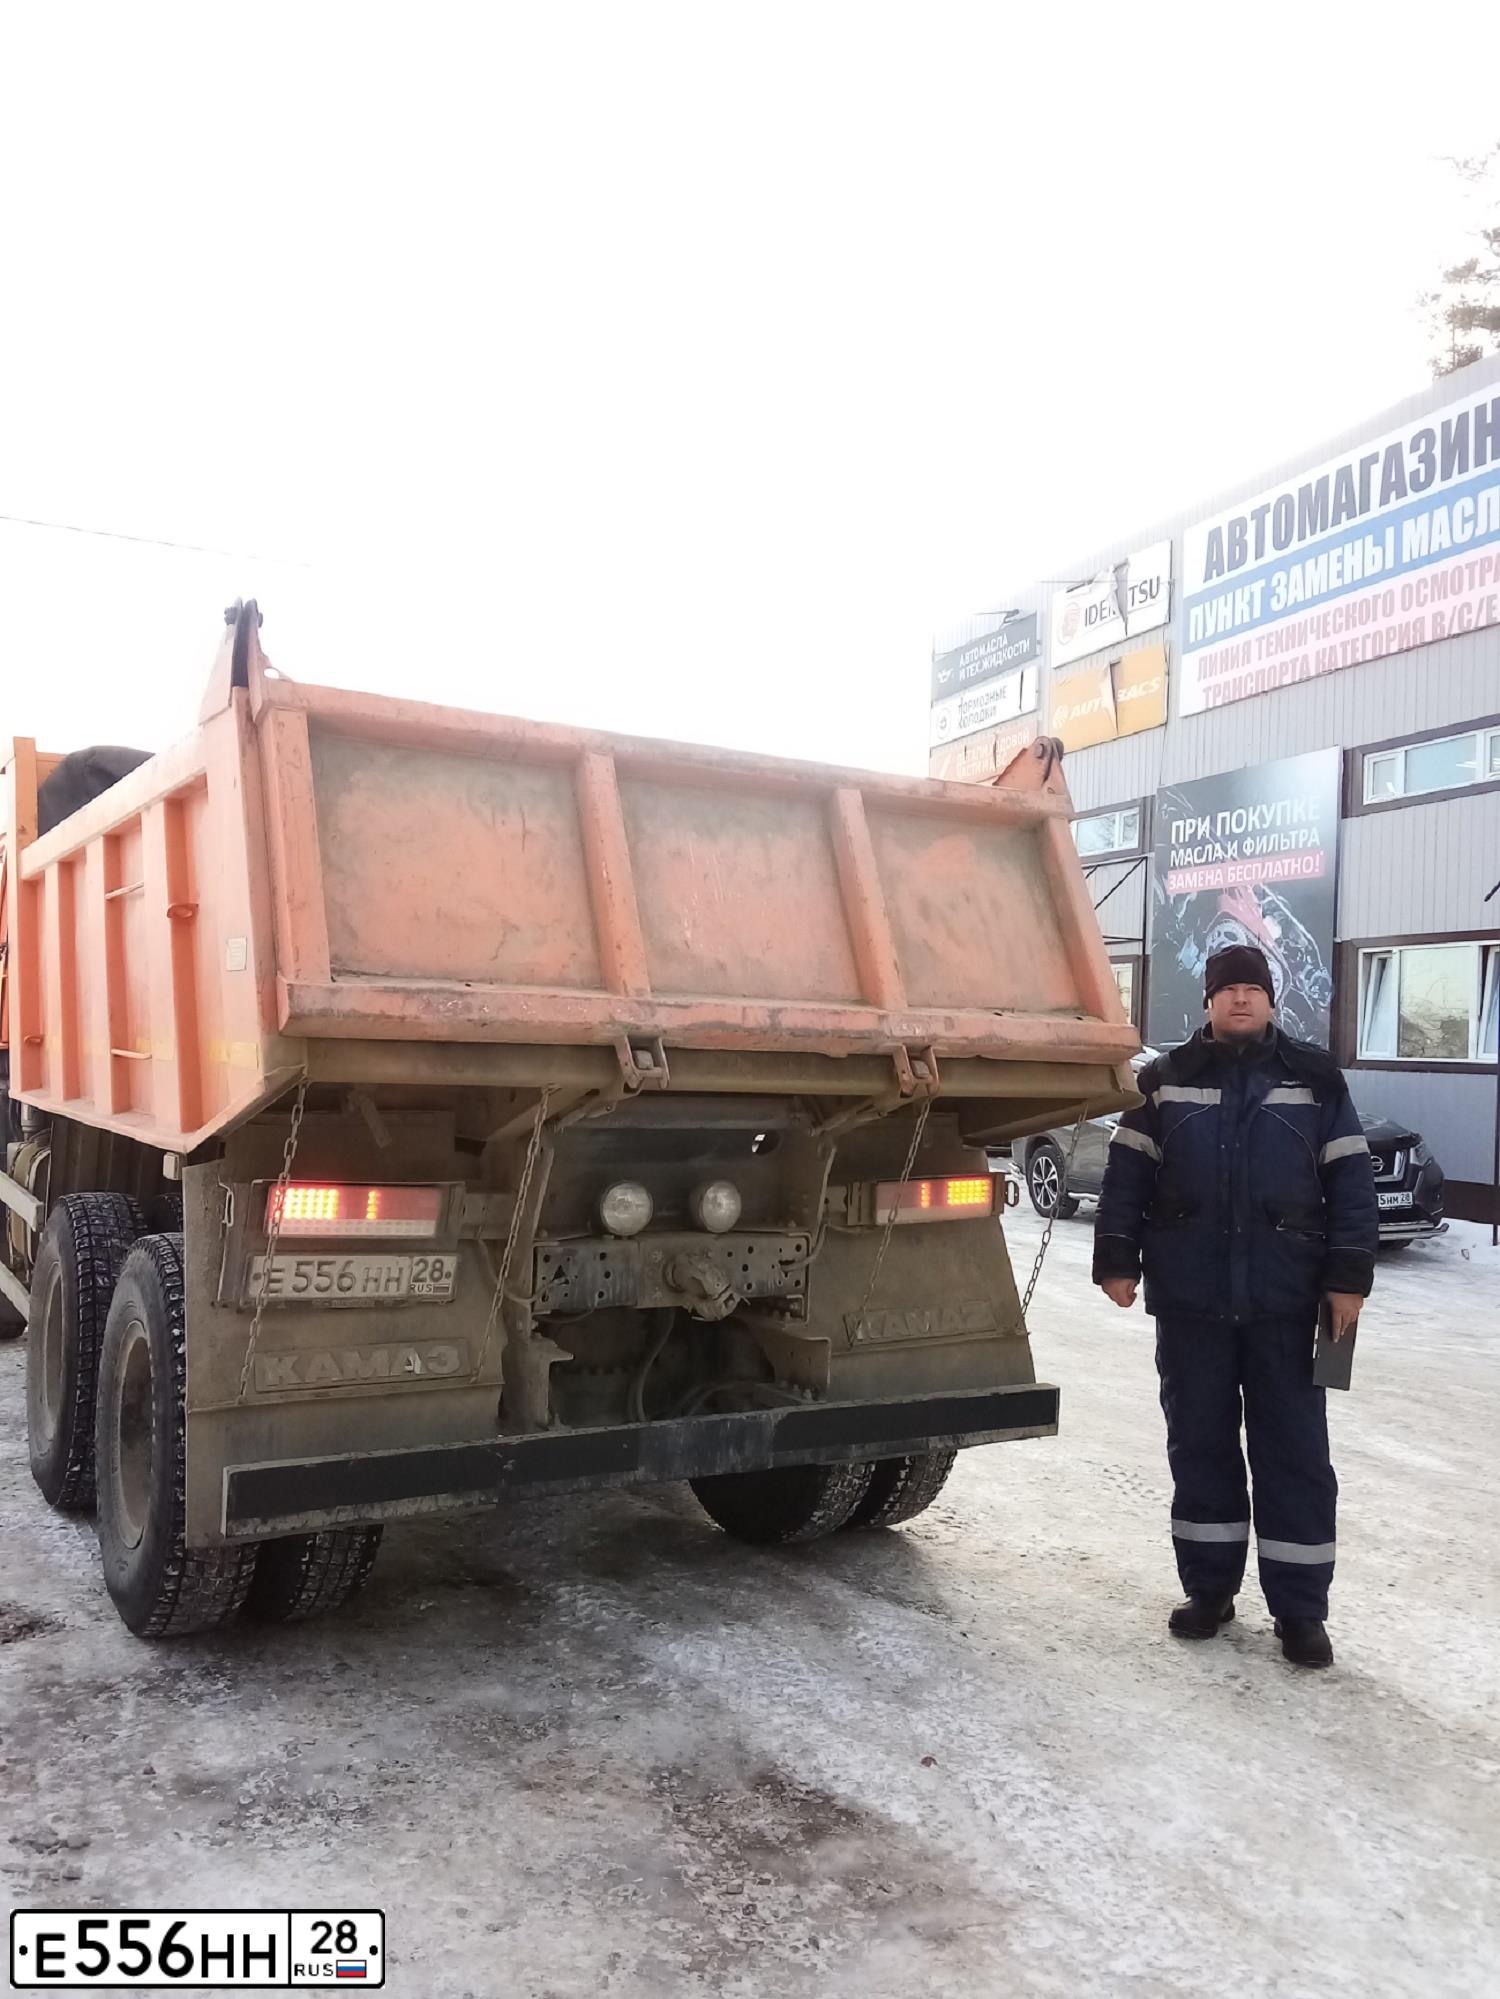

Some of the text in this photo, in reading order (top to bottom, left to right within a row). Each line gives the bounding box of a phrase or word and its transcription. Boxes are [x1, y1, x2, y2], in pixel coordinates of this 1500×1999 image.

[1203, 396, 1500, 584] АВТОМАГАЗИН
[1084, 575, 1161, 627] IDETSU
[1189, 578, 1266, 644] ПУНКТ
[1271, 526, 1394, 613] ЗАМЕНЫ
[1197, 640, 1252, 682] ЛИНИЯ
[1256, 588, 1395, 661] ТЕХНИЧЕСКОГО
[1202, 653, 1311, 709] ТРАНСПОРТА
[1315, 615, 1426, 677] КАТЕГОРИЯ
[1069, 677, 1162, 720] AUTBACS
[1171, 794, 1321, 844] ПРИ ПОКУПКЕ
[1170, 827, 1321, 867] МАСЛА И ФИЛЬТРА
[1169, 868, 1224, 890] ЗАМЕНА
[410, 1283, 433, 1293] RUS
[412, 1258, 444, 1283] 28
[264, 1345, 460, 1387] КАМАЗ
